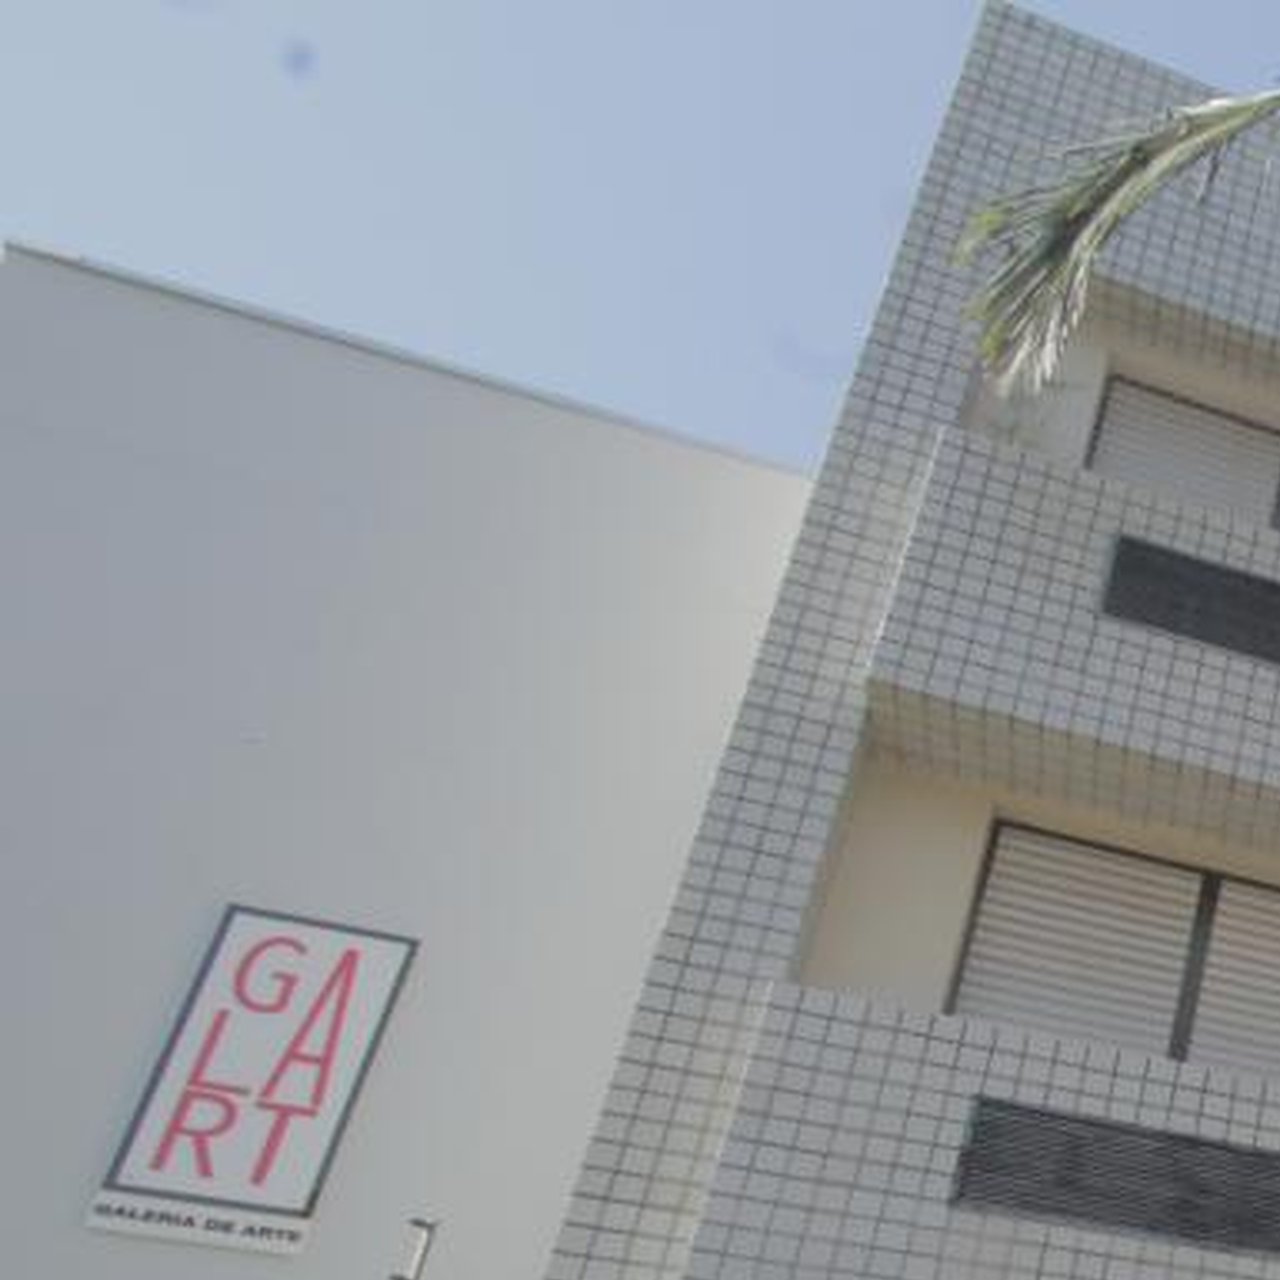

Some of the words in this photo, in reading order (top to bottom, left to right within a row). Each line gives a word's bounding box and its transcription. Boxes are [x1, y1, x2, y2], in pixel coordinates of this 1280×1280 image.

[93, 1203, 197, 1229] GALERIA
[204, 1217, 236, 1235] DE
[240, 1225, 302, 1243] ARTE
